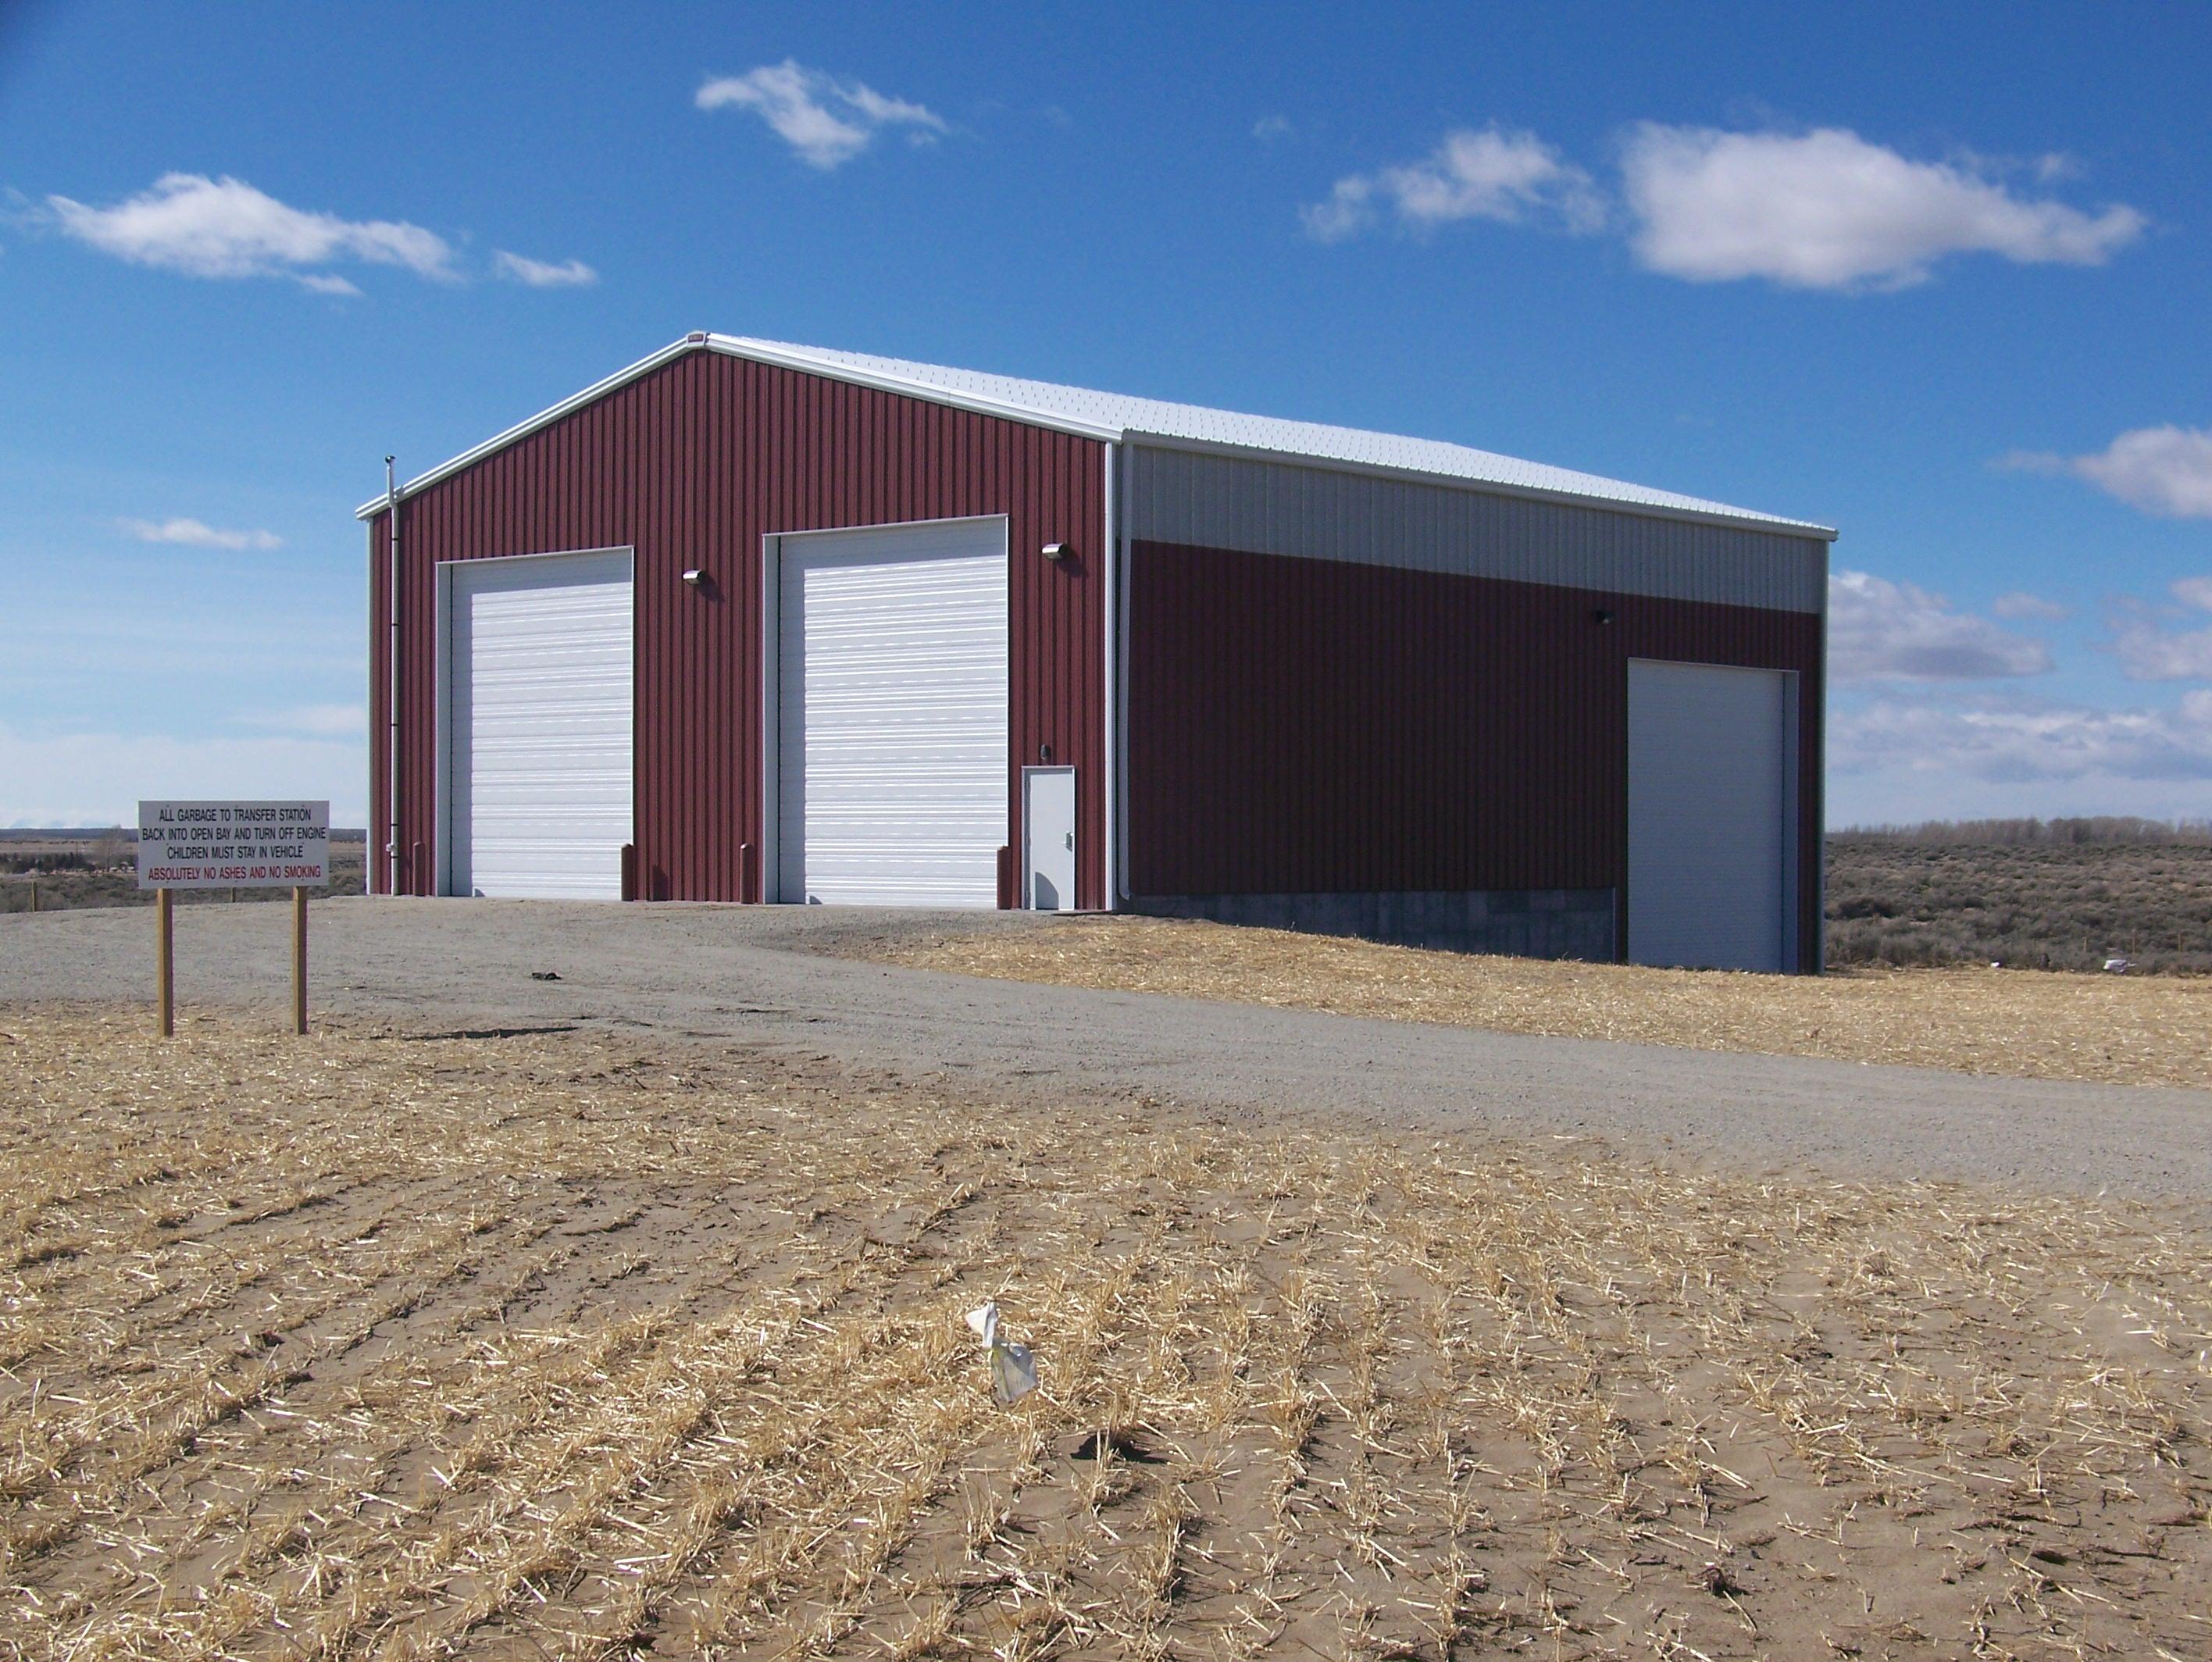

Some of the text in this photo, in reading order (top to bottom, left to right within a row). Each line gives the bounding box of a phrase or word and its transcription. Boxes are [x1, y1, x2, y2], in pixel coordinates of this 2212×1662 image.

[159, 808, 312, 821] ALL GARBAGE TO TRANSFER STATION
[142, 827, 326, 840] BACK INTO OPEN BAY AND TURN OFF ENGINE
[167, 845, 303, 859] CHILDREN MUST STAY IN VEHICLE
[148, 865, 321, 880] ABSOLUTELY NO ASHES AND NO SMOKING
